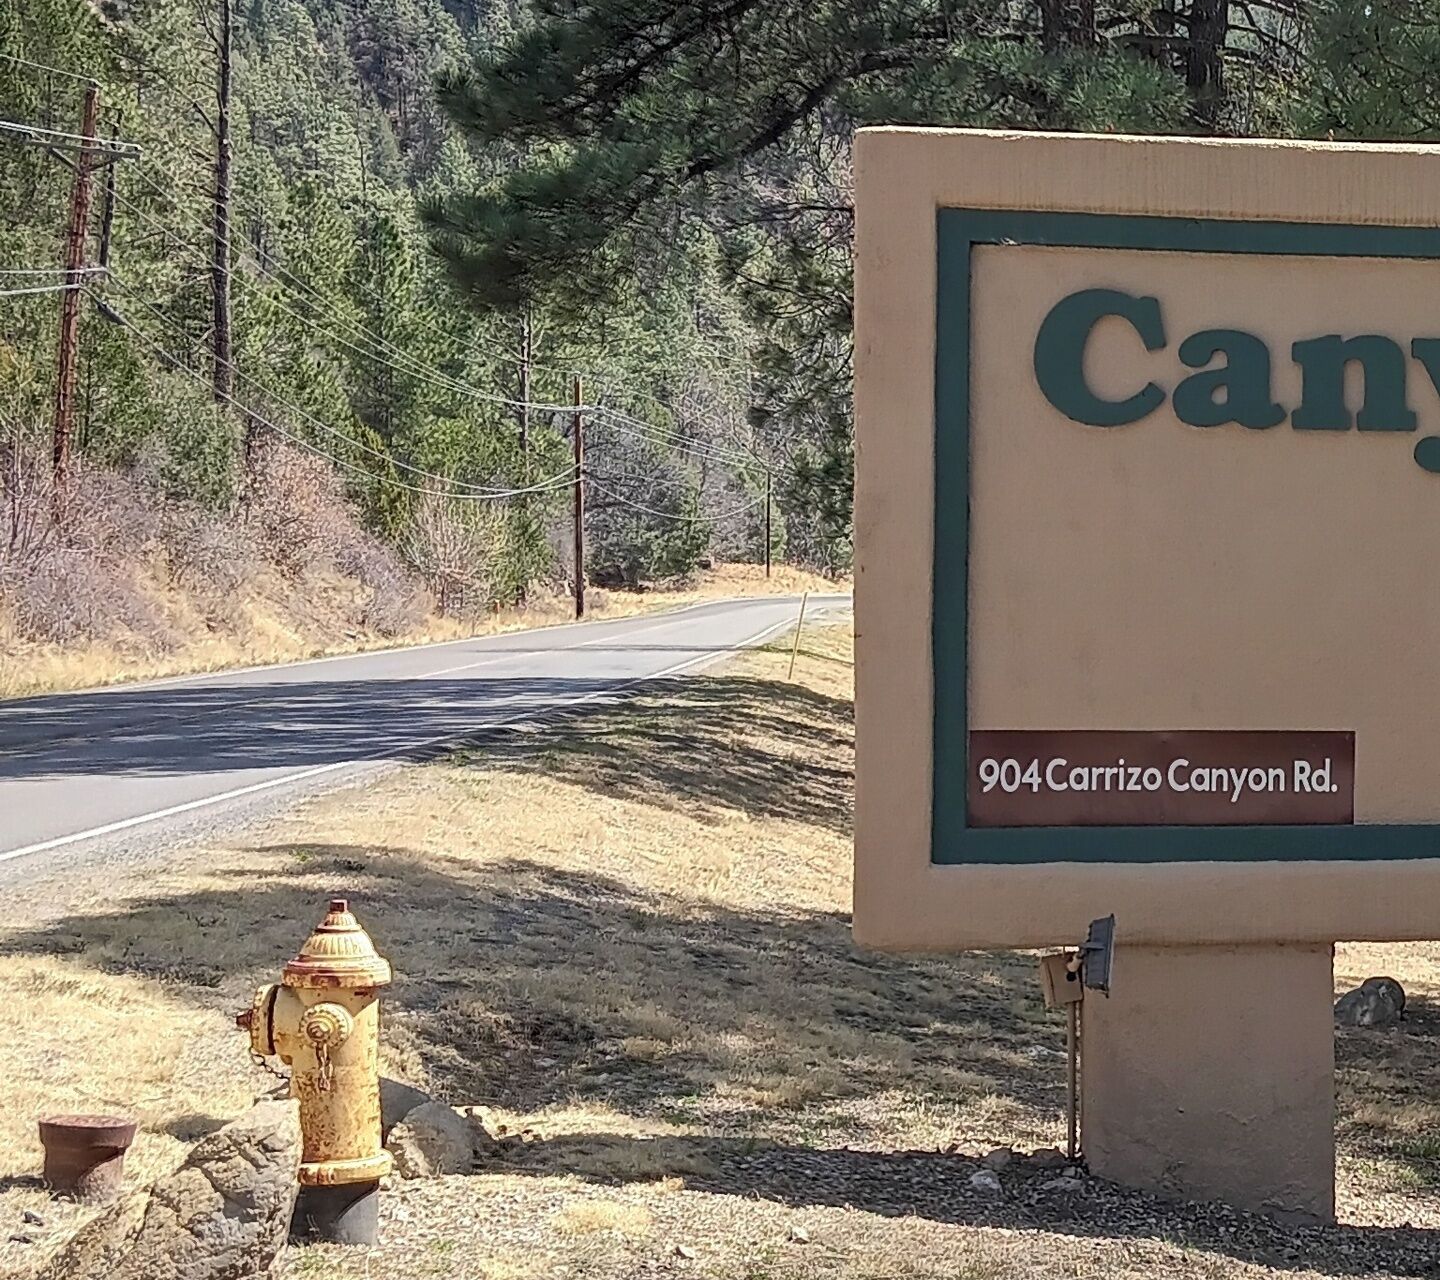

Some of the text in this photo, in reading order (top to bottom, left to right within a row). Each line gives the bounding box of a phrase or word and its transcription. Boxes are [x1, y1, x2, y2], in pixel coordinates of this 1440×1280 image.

[978, 756, 1339, 803] 904 Carrizo Canyon Rd.
